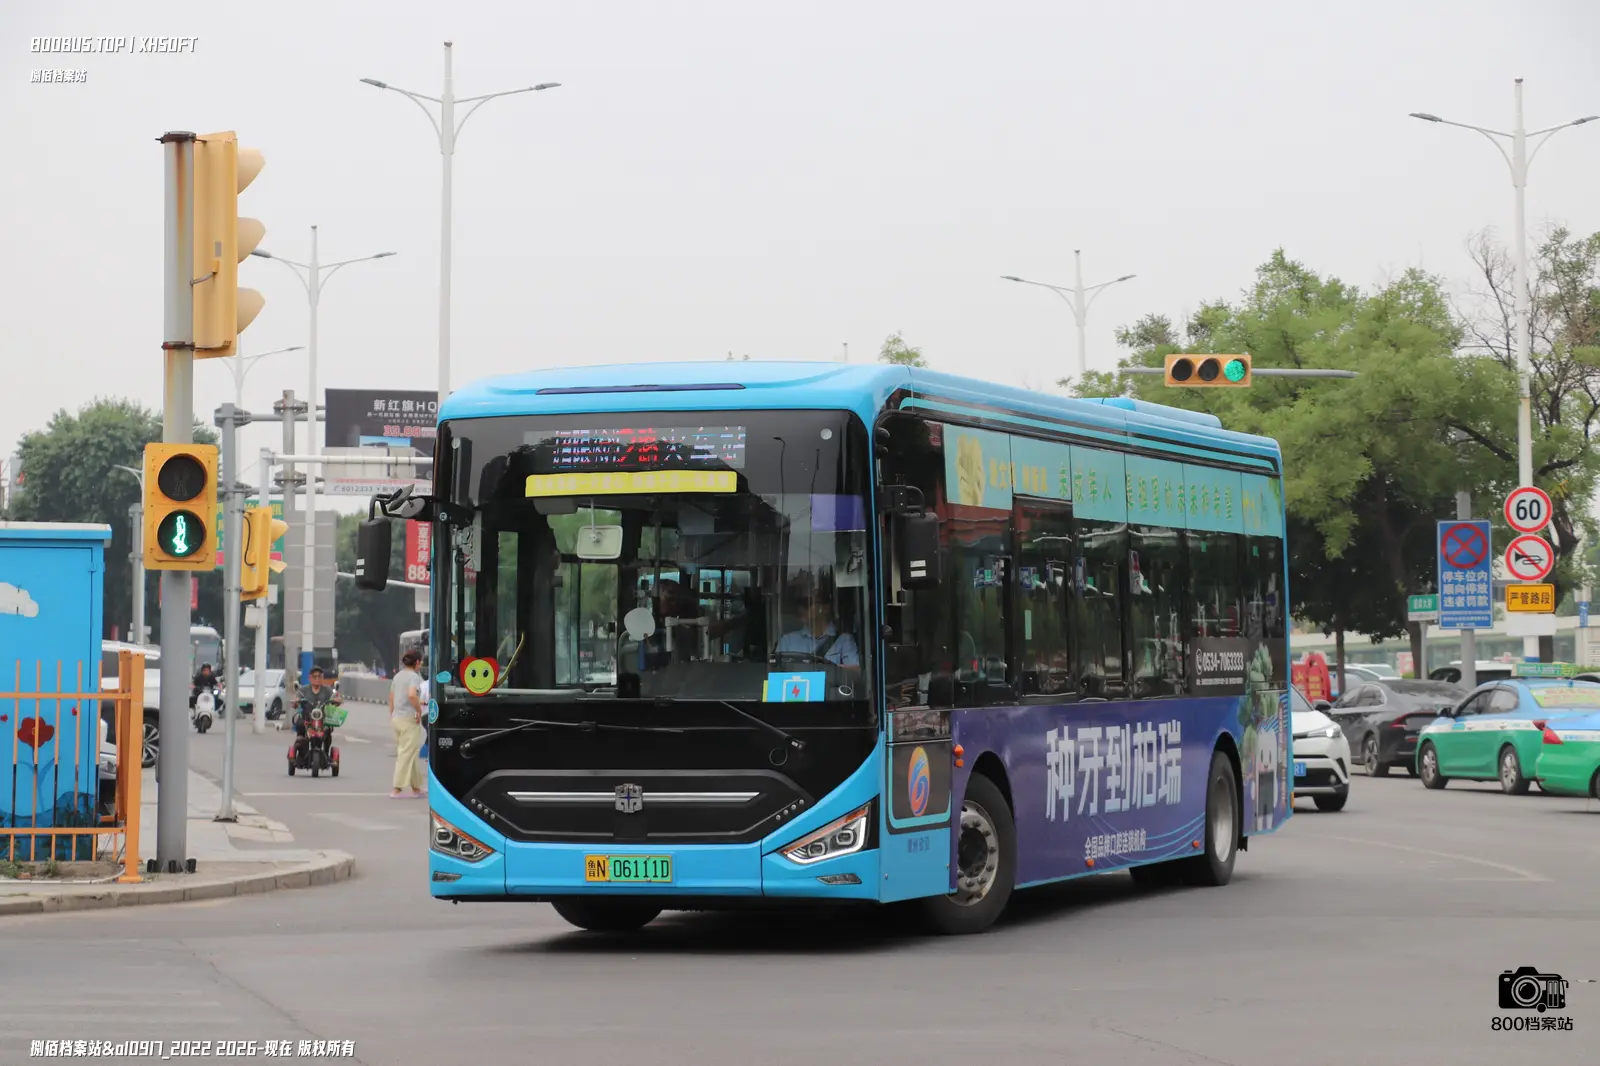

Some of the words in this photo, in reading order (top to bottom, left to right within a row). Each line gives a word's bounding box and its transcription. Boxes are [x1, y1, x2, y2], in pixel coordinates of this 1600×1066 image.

[1515, 499, 1541, 521] 60
[1442, 570, 1488, 583] 停车位内
[1509, 591, 1550, 605] 严管路段
[1046, 719, 1182, 822] 种牙到柏瑞
[613, 859, 670, 878] 06111D
